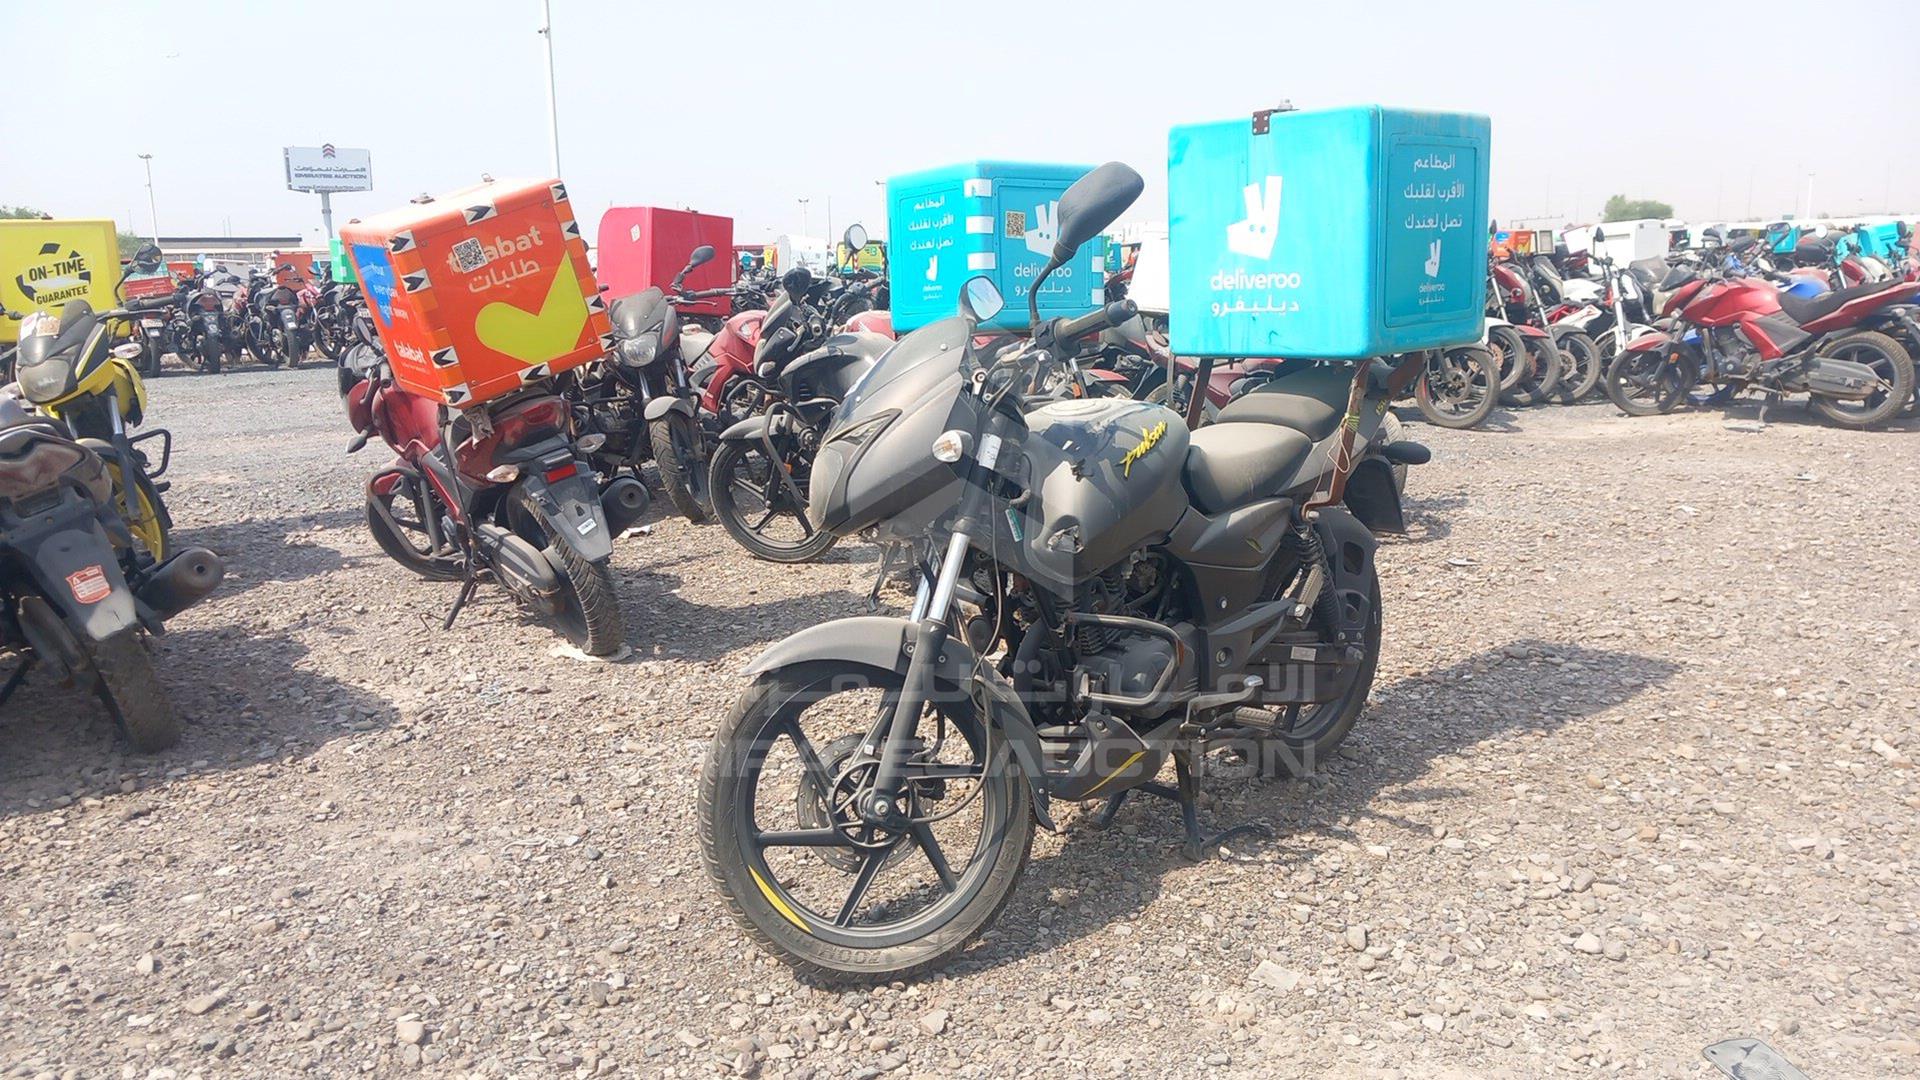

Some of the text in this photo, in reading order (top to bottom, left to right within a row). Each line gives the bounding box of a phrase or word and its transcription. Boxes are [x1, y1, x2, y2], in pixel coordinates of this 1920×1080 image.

[1413, 153, 1456, 173] المطاعم
[1403, 183, 1436, 203] لقلبك
[446, 225, 544, 274] tabat
[28, 258, 87, 282] ON-TIME
[468, 258, 541, 293] طلبات
[1014, 262, 1073, 278] delivroo
[1210, 268, 1302, 290] deliveroo
[36, 285, 89, 305] GUARANTEE
[1014, 281, 1072, 297] ديليرو
[1211, 294, 1301, 318] ديليفرو
